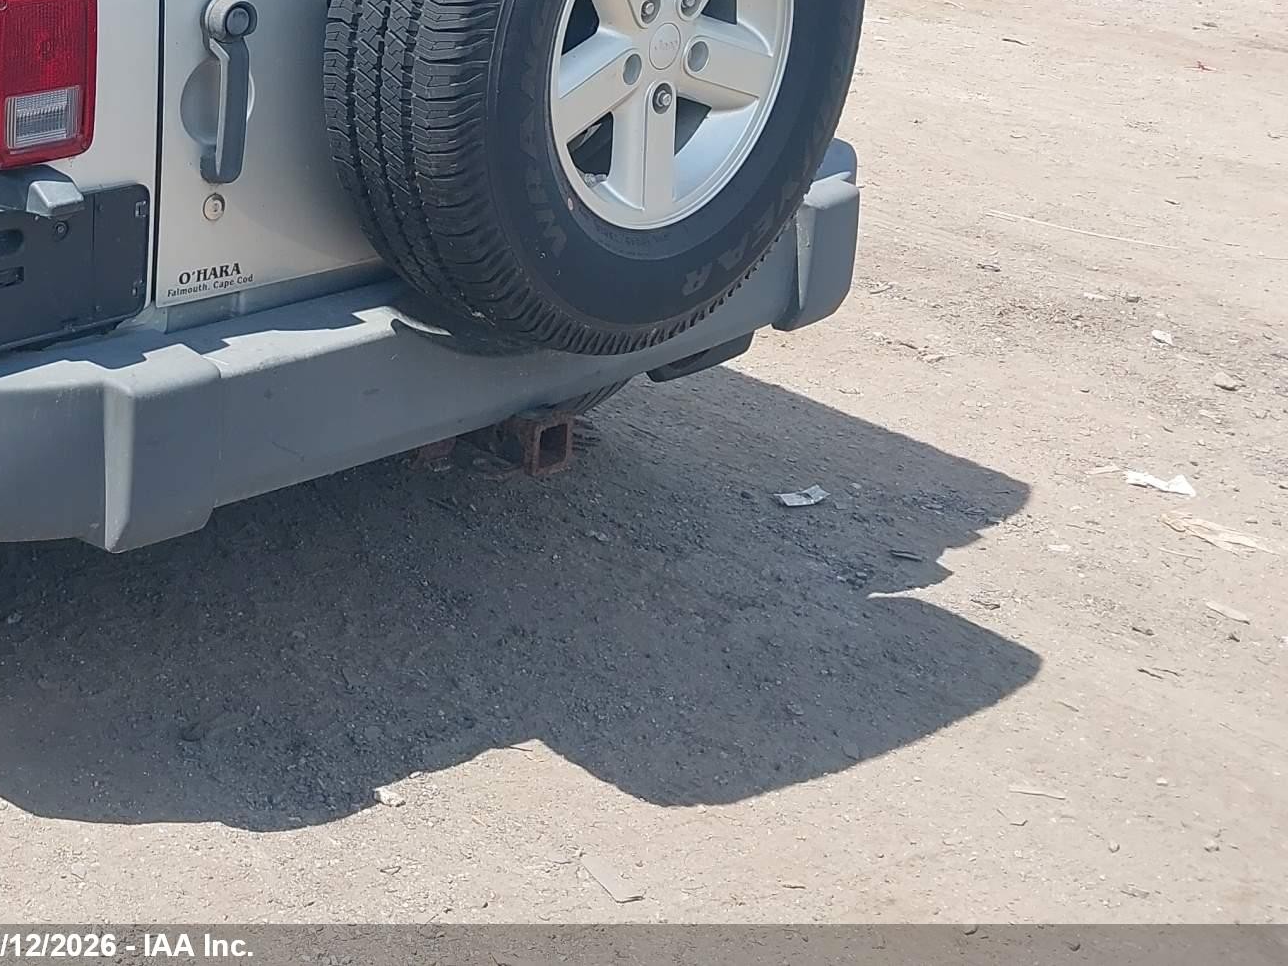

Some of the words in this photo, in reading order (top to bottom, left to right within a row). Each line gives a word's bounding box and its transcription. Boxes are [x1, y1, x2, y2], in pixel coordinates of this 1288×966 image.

[179, 263, 241, 284] O'HARA
[213, 279, 234, 289] Cape
[237, 274, 254, 284] Cod
